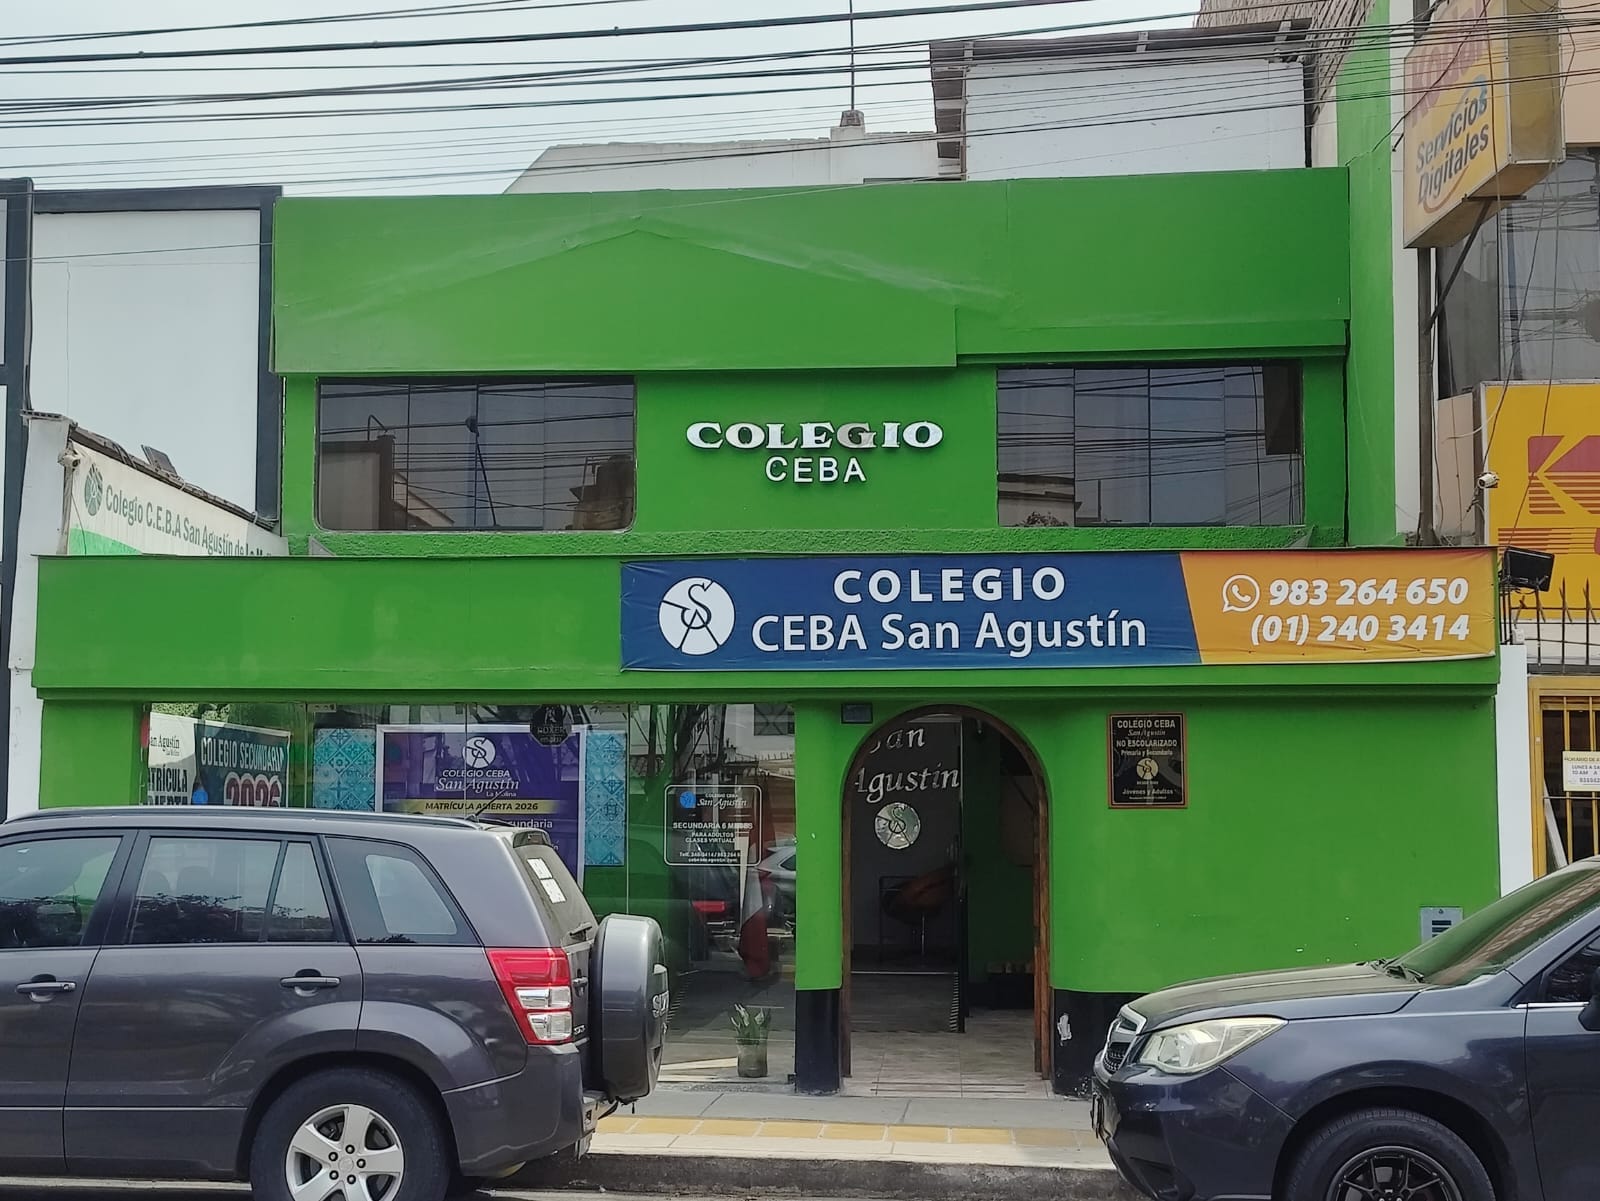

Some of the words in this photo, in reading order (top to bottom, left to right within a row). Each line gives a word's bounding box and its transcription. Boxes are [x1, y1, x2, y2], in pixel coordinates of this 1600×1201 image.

[1416, 93, 1488, 171] Servicios
[1418, 124, 1490, 204] Digitales
[686, 421, 943, 449] COLEGIO
[765, 456, 867, 483] CEBA
[106, 484, 144, 526] Colegio
[183, 517, 200, 546] San
[202, 525, 234, 555] Agustín
[833, 566, 1065, 603] COLEGIO
[1269, 578, 1329, 606] 983
[1336, 578, 1398, 606] 264
[1406, 577, 1469, 605] 650
[752, 614, 868, 652] CEBA
[881, 613, 960, 650] San
[975, 609, 1146, 658] Agustín
[1251, 614, 1310, 646] (01)
[1317, 614, 1379, 642] 240
[1386, 614, 1470, 642] 3414
[1117, 719, 1152, 728] COLEGIO
[1154, 719, 1176, 728] CEBA
[201, 736, 238, 768] COLEGIO
[870, 727, 925, 754] an
[436, 777, 462, 791] San
[463, 777, 519, 793] Agustín
[442, 769, 483, 778] COLEGIO
[486, 769, 511, 778] CEBA
[514, 802, 539, 810] 2026
